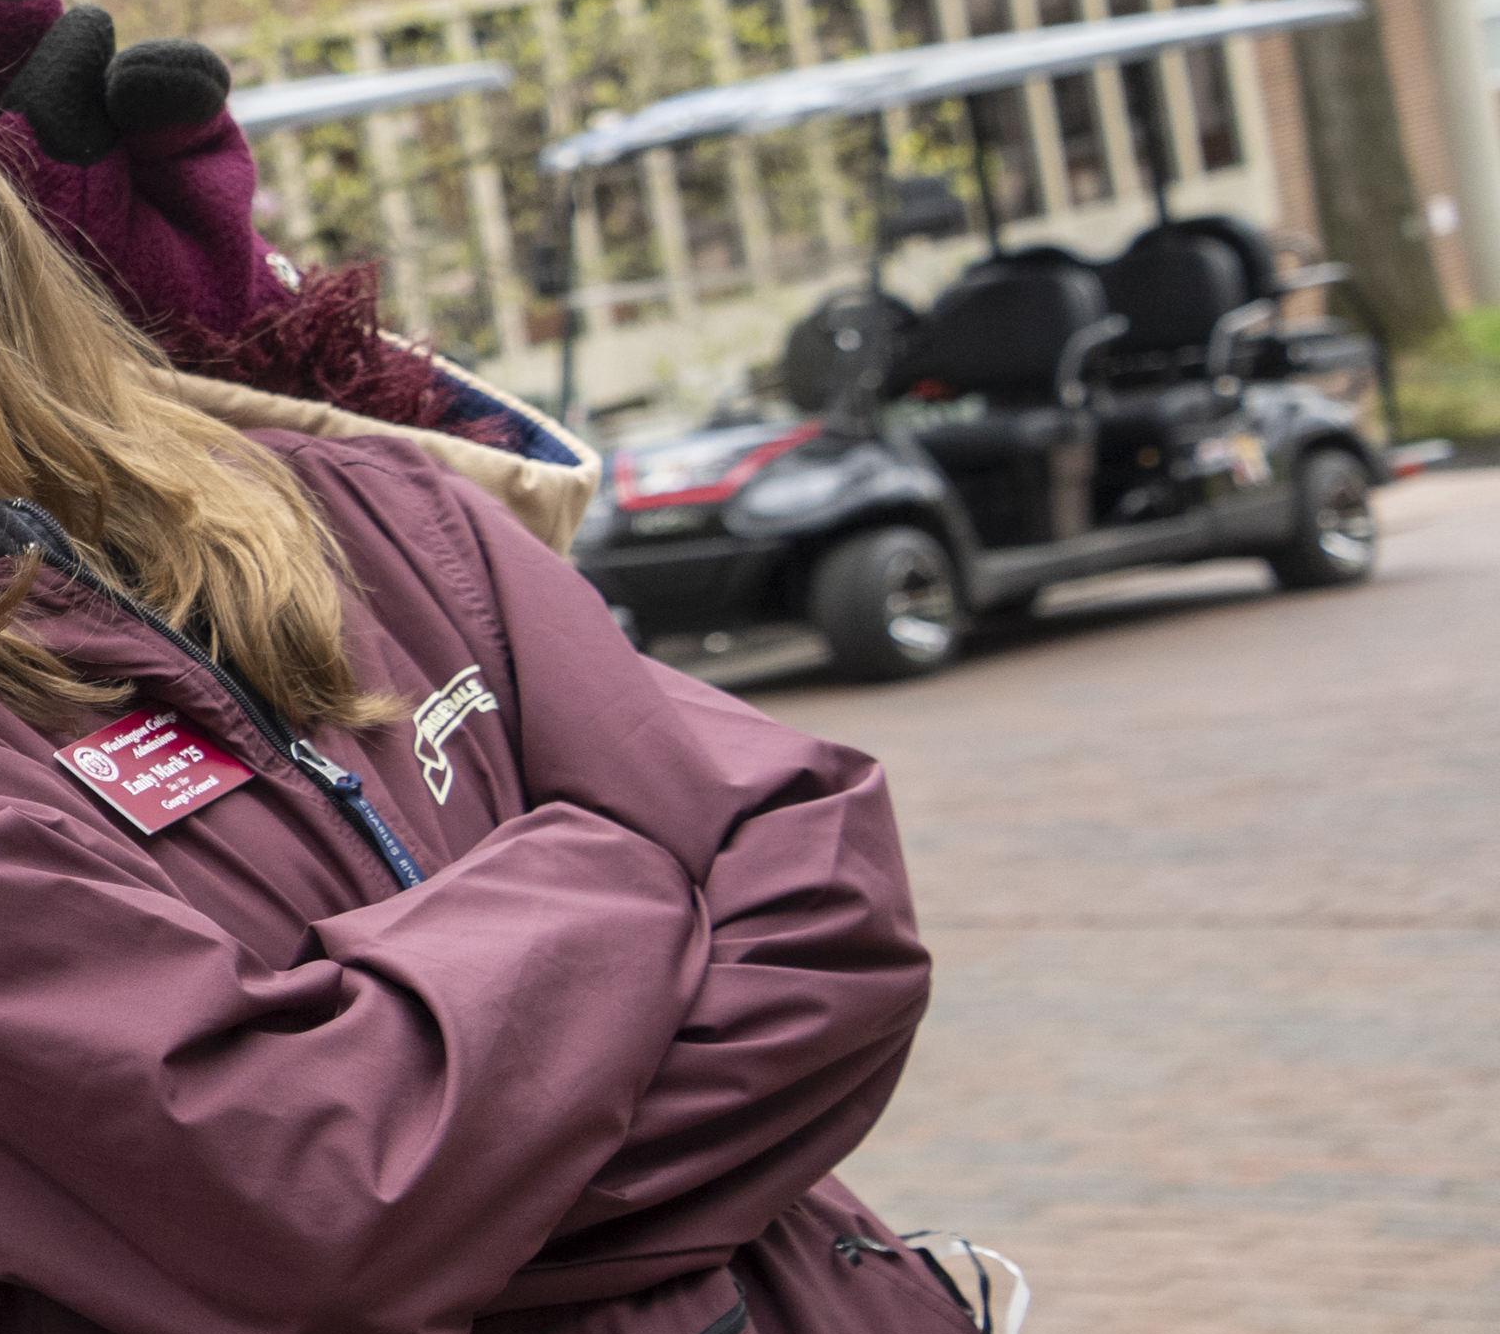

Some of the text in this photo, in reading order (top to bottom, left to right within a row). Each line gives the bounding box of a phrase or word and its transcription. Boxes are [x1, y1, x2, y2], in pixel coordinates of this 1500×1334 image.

[100, 726, 150, 754] Washington
[132, 730, 178, 759] Admissions
[121, 773, 160, 795] Emily
[149, 755, 190, 781] Marik
[161, 774, 219, 810] George's General
[358, 799, 400, 856] CHARLES
